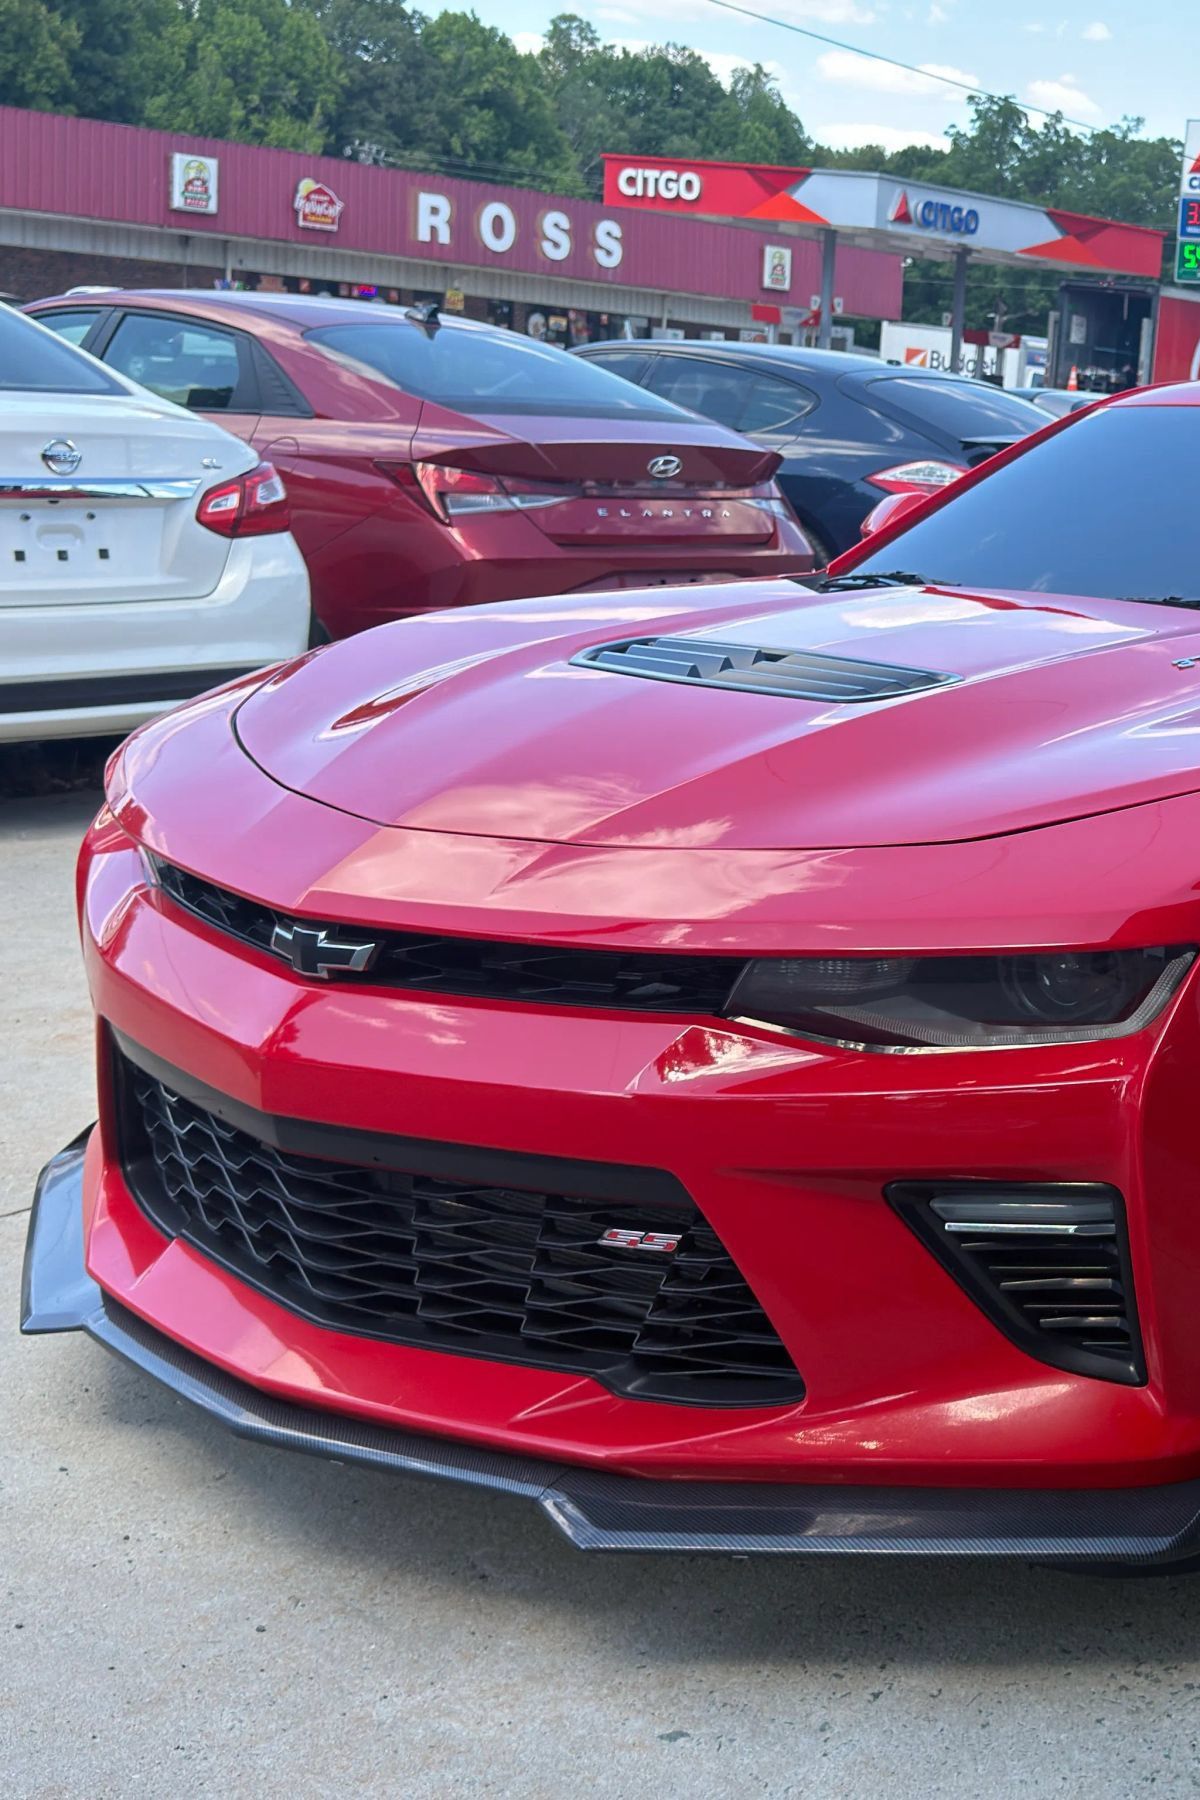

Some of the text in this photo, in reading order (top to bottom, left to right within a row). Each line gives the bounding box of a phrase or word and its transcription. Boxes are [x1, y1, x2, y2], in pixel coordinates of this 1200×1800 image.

[617, 167, 701, 201] CITGO
[417, 192, 623, 268] ROSS
[918, 200, 980, 235] CITGO
[597, 507, 730, 517] ELANTRA
[597, 1228, 682, 1252] SS
